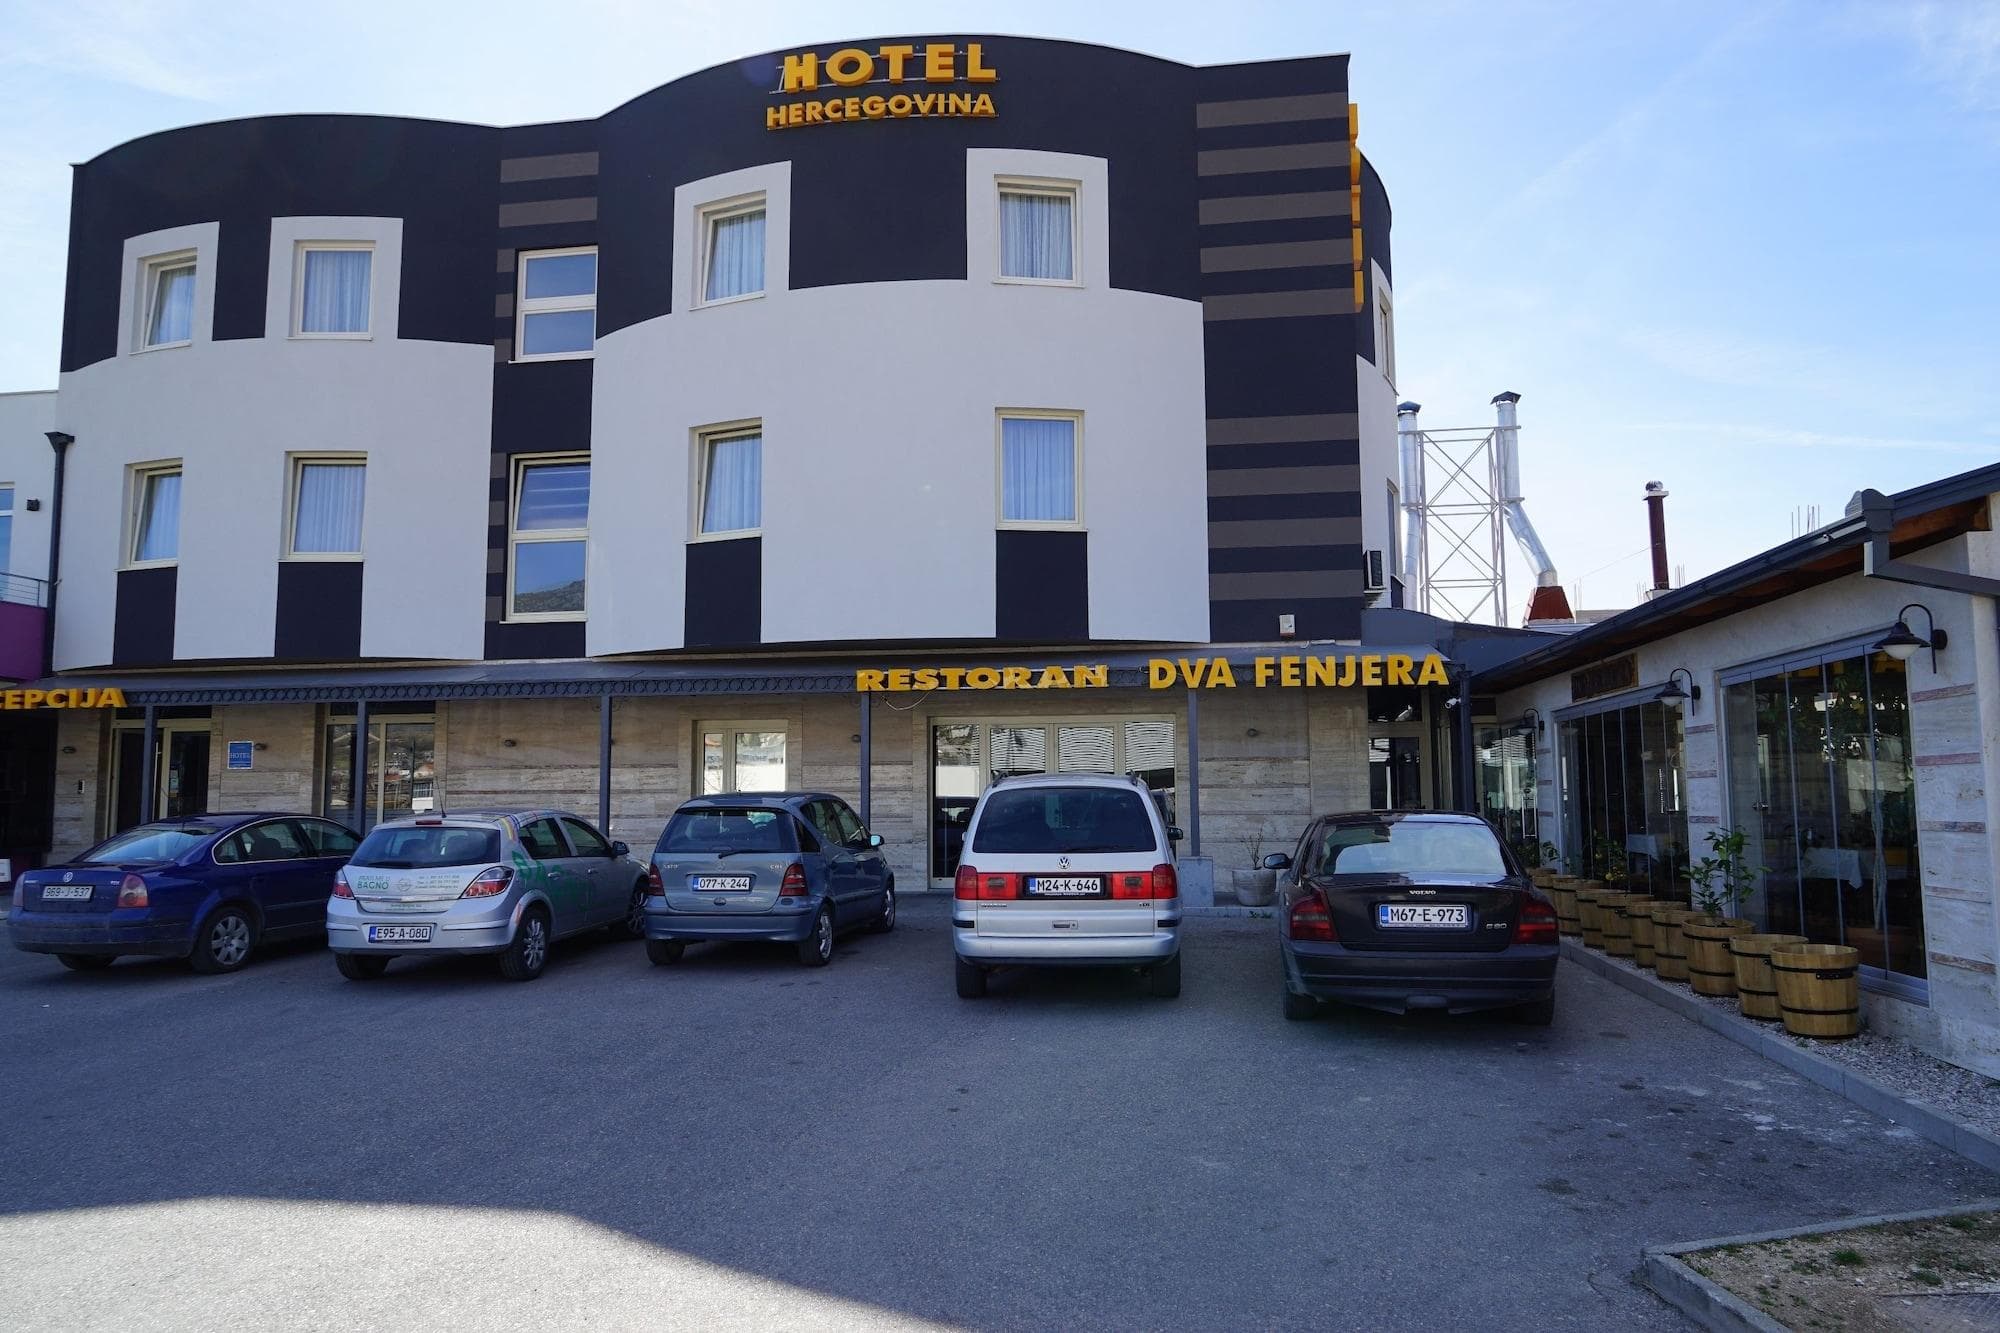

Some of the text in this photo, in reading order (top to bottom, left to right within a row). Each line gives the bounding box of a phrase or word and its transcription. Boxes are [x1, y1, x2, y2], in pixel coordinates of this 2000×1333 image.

[783, 43, 997, 93] HOTEL
[766, 93, 997, 130] HERCEGOVINA
[856, 664, 1109, 692] RESTORAN
[1149, 653, 1451, 689] DVA FENJERA
[0, 687, 128, 710] EPCIJA
[357, 881, 389, 890] BAGNO
[700, 878, 748, 889] 077-K-244
[1037, 879, 1098, 891] M24-K-646
[1390, 908, 1464, 922] M67-E-973
[377, 928, 428, 939] E95-A-080
